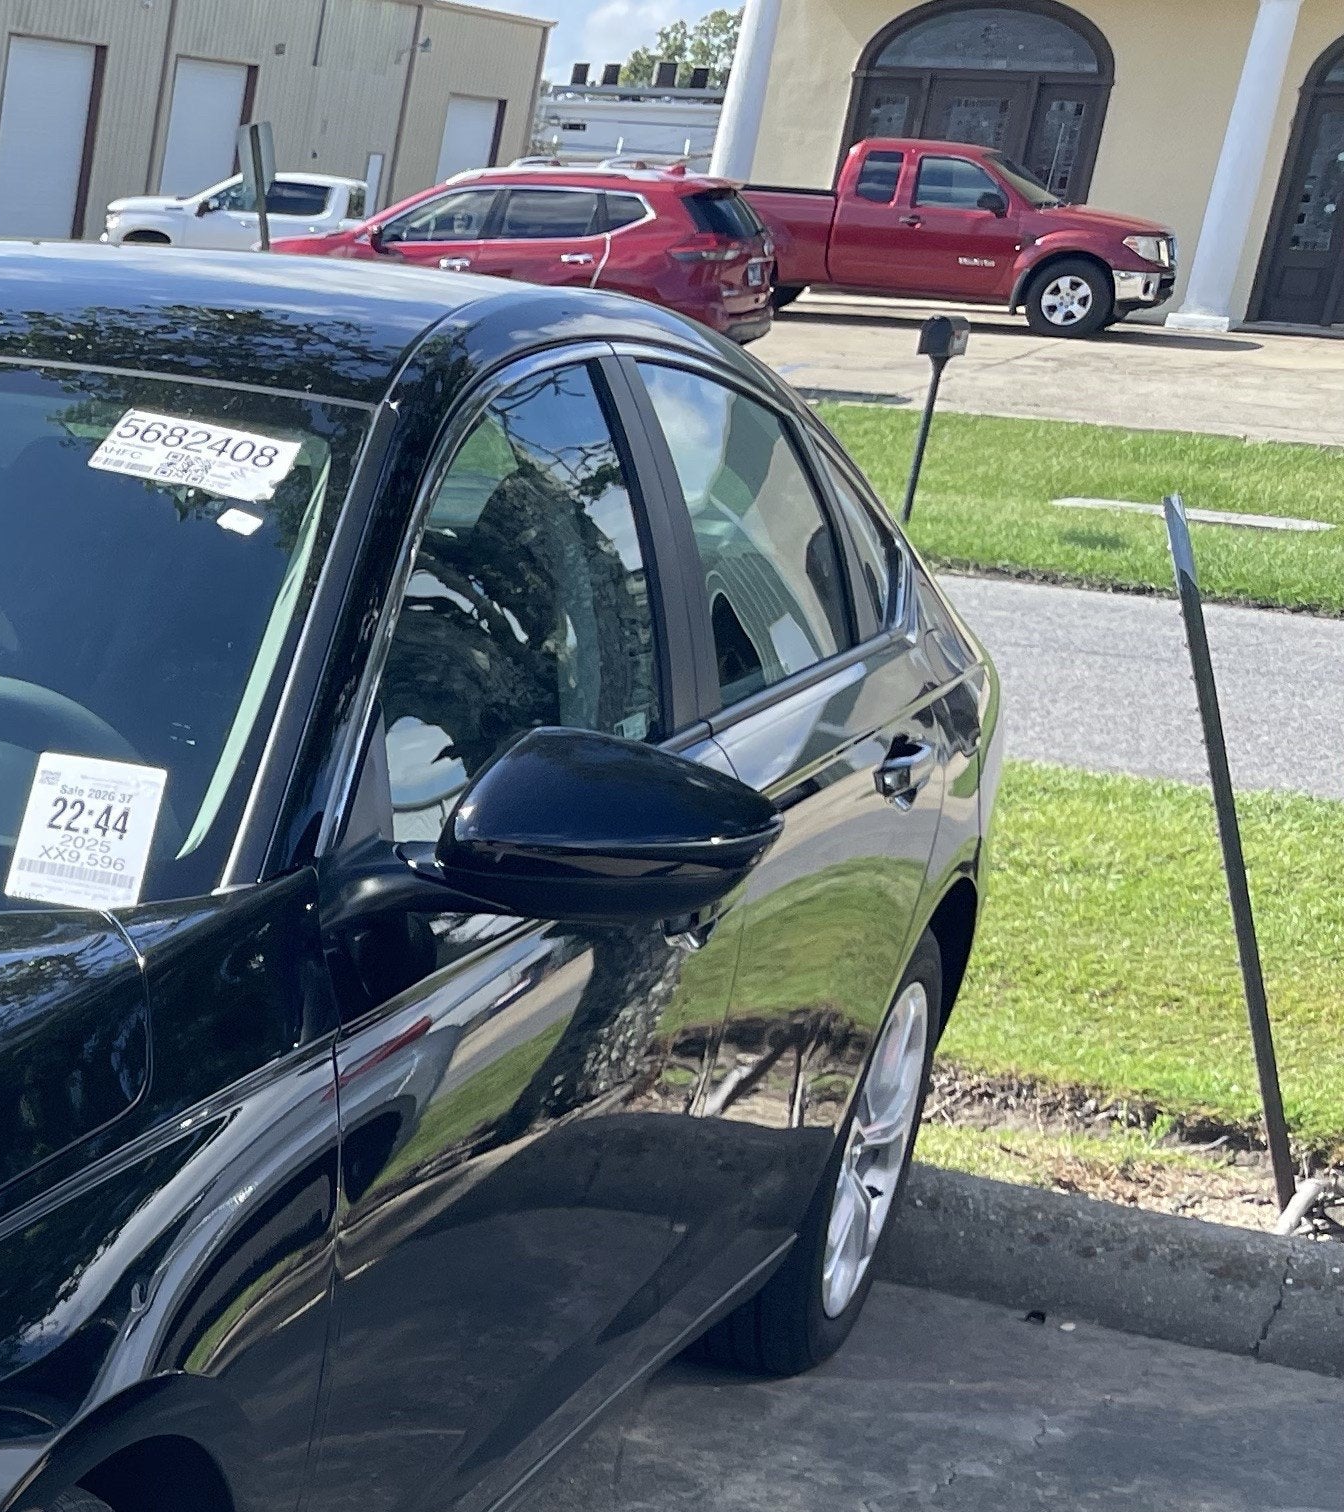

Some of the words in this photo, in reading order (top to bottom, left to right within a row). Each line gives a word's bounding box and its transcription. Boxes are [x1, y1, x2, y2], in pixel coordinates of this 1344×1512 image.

[116, 417, 280, 468] 5682408
[60, 784, 85, 797] Sale
[46, 796, 131, 840] 22:44
[59, 834, 112, 853] 2025
[38, 845, 126, 872] XX9,596
